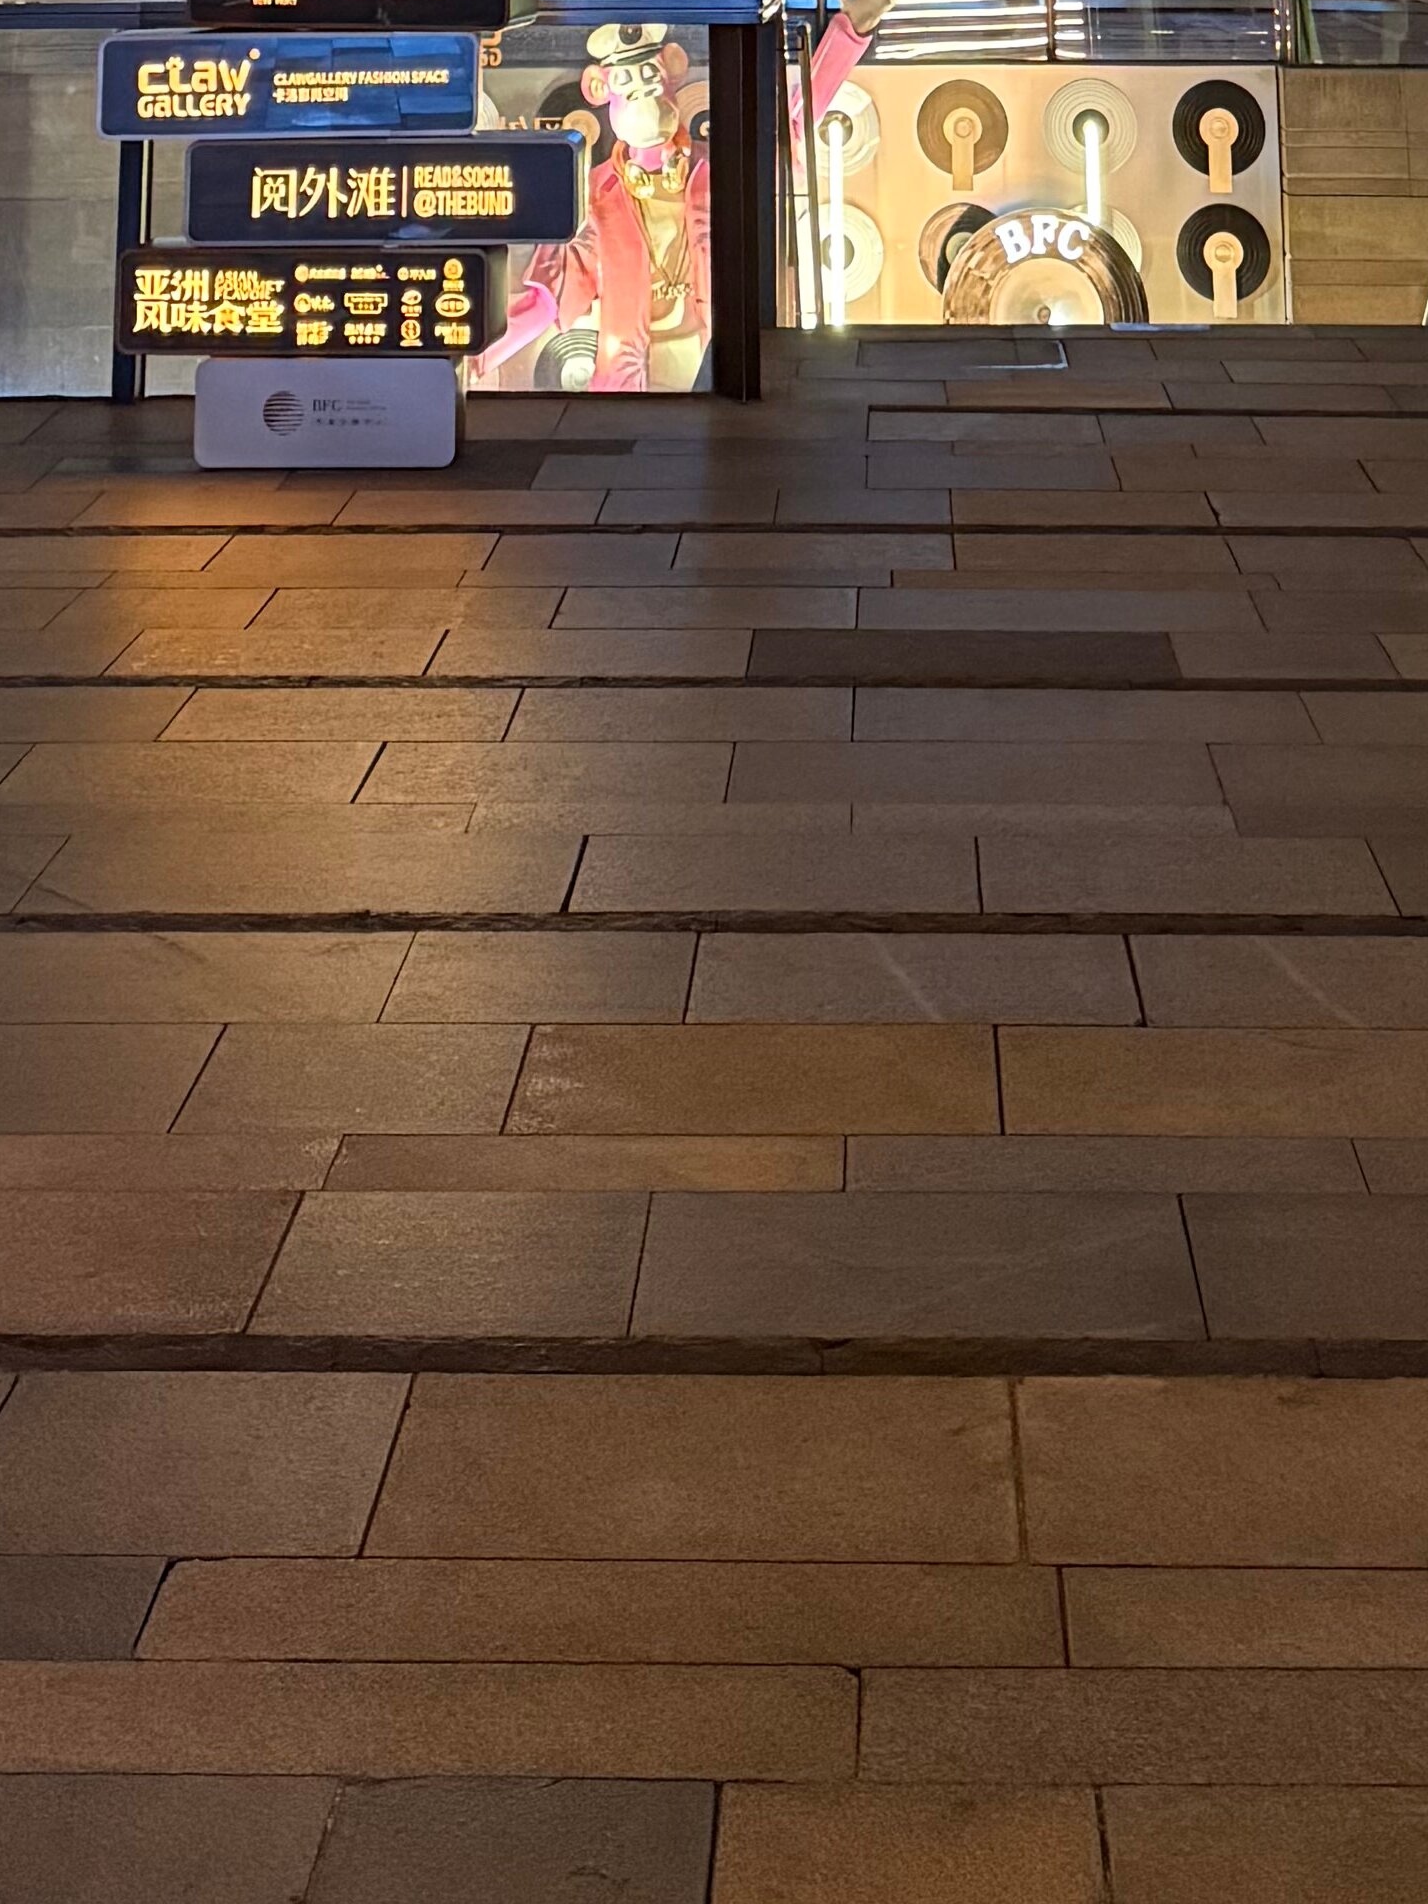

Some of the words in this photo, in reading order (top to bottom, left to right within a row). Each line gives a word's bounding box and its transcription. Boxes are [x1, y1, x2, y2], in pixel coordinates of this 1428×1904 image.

[358, 71, 410, 85] FASHION
[411, 69, 450, 84] SPACE
[251, 166, 396, 219] 阅外滩
[413, 165, 514, 189] READ&SOCIAL
[413, 189, 514, 218] @THEBUND
[994, 214, 1090, 264] BFC
[133, 269, 209, 302] 亚洲
[132, 299, 285, 335] 风味食堂
